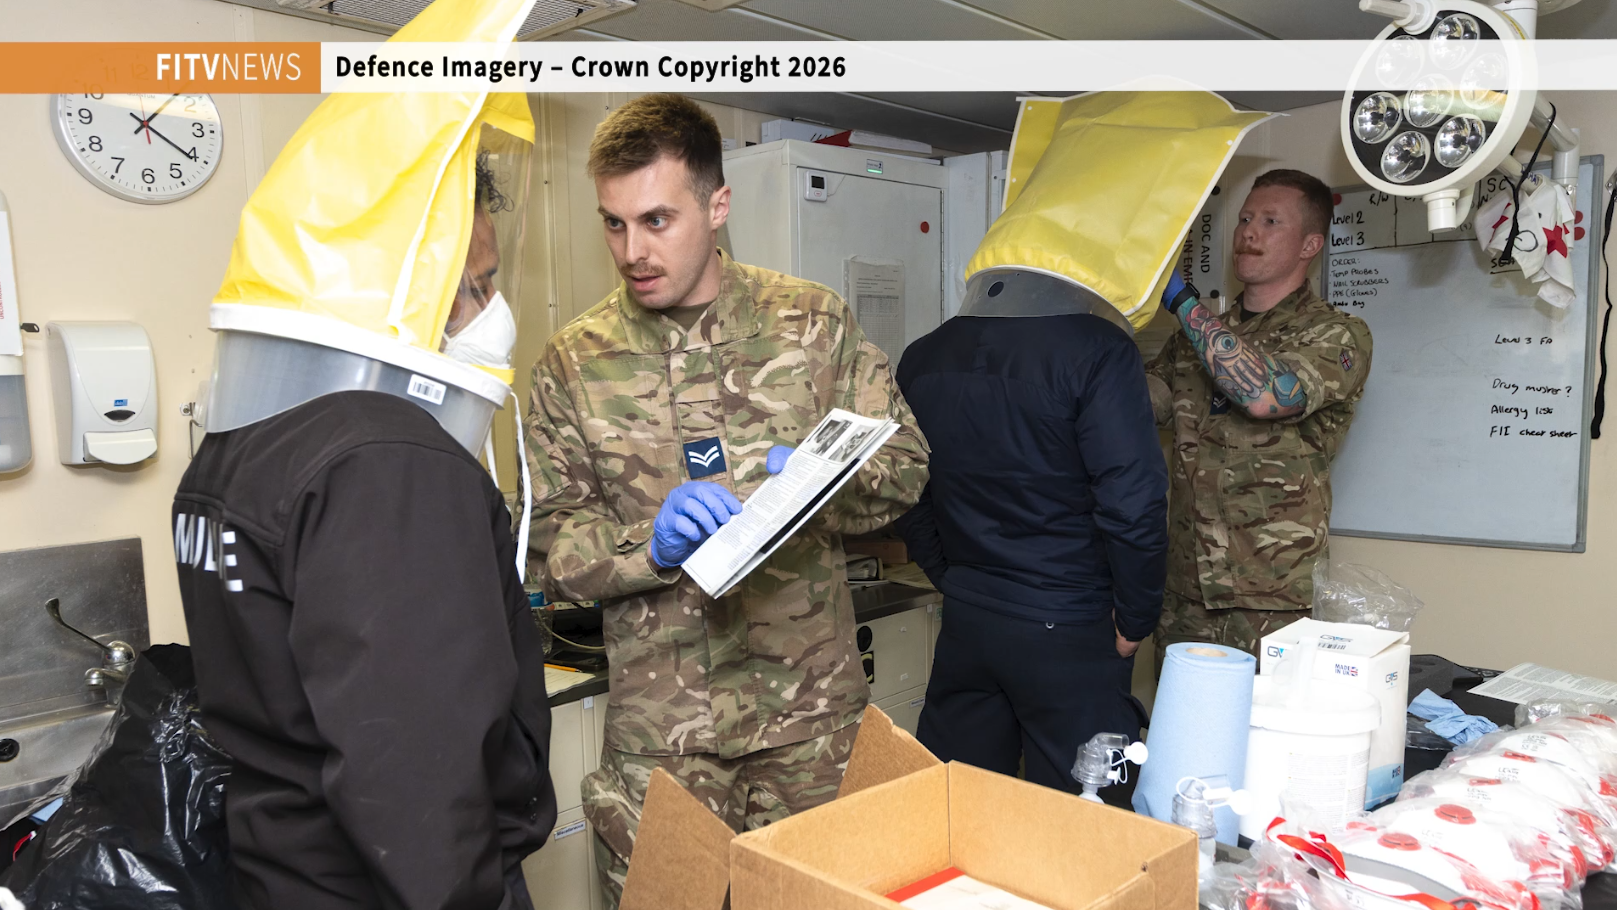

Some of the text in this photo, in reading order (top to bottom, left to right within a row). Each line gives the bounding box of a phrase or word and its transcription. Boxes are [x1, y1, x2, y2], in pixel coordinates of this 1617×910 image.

[184, 96, 197, 113] 2
[78, 108, 93, 125] 9
[191, 122, 205, 138] 3
[88, 135, 103, 152] 8
[187, 146, 199, 162] 4
[110, 156, 125, 174] 7
[169, 163, 183, 179] 5
[141, 168, 155, 184] 6
[1332, 210, 1365, 225] Level 2
[1200, 213, 1212, 274] DOC AND
[1331, 231, 1365, 247] Level 3
[1492, 378, 1519, 395] Drug
[1490, 404, 1528, 420] Allergy
